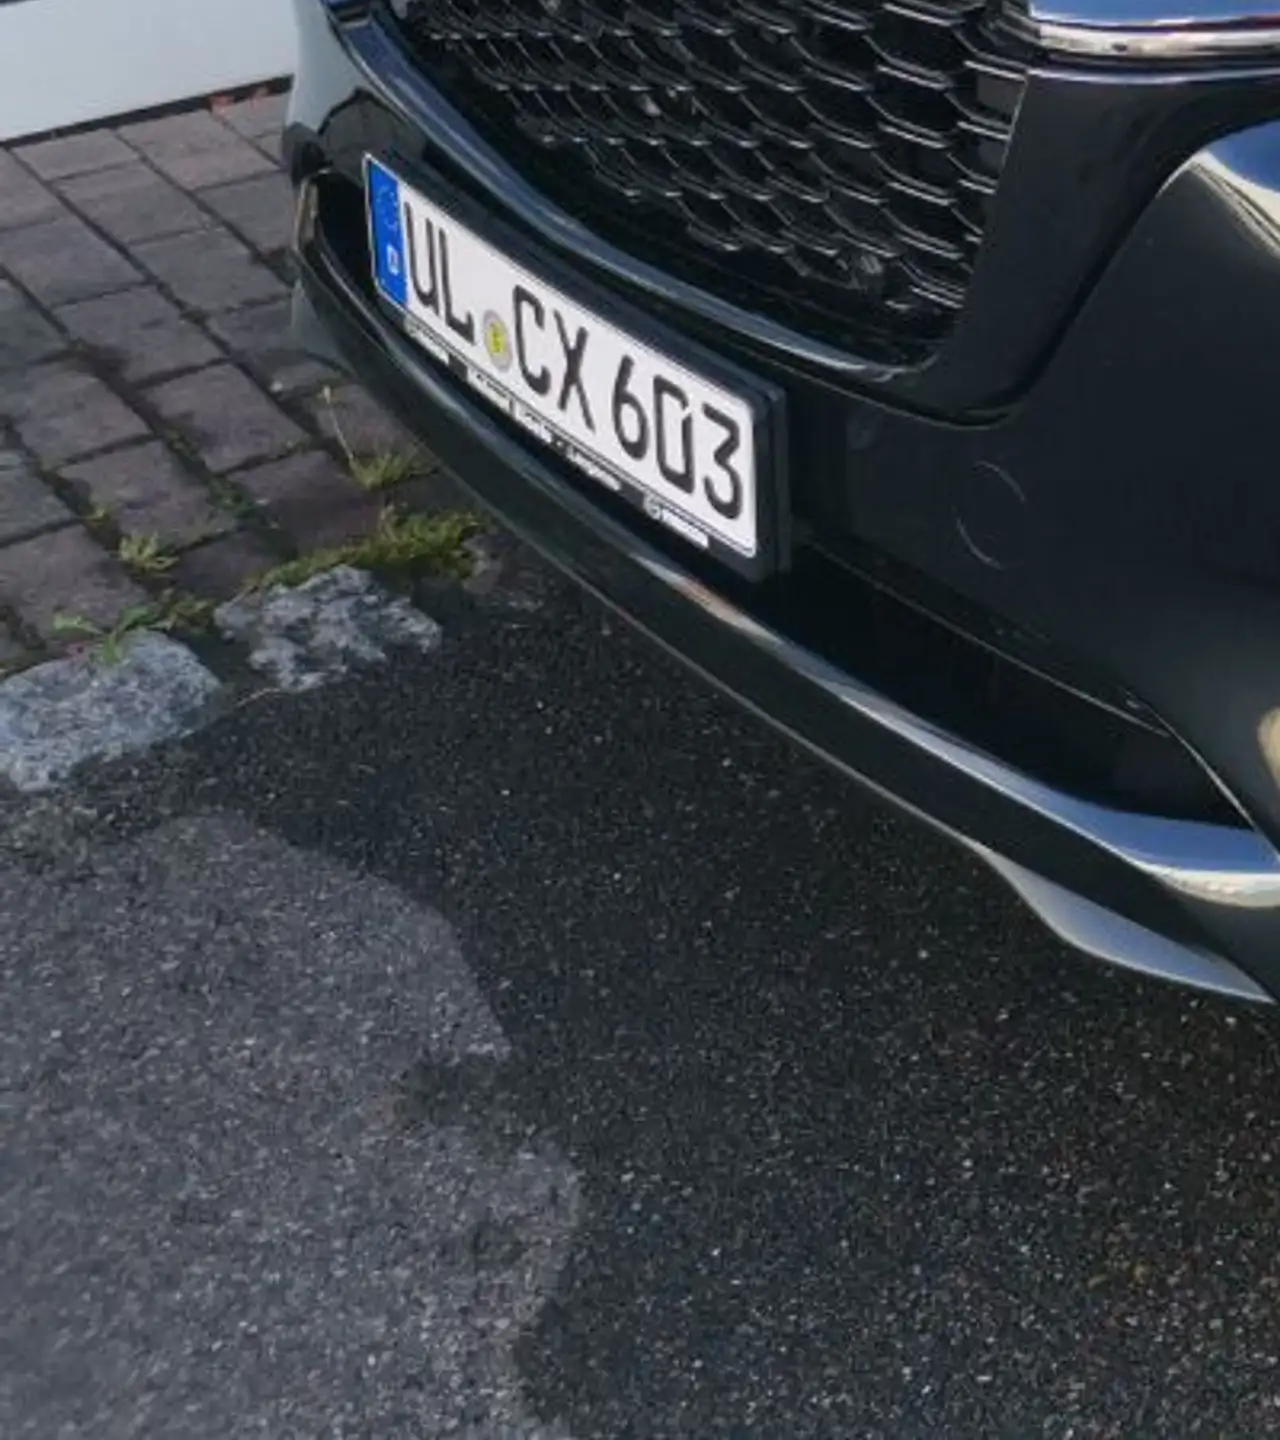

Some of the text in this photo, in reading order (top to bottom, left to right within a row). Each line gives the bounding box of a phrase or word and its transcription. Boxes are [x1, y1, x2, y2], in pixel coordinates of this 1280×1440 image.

[403, 201, 475, 346] UL
[512, 284, 597, 434] CX
[611, 354, 743, 520] 603
